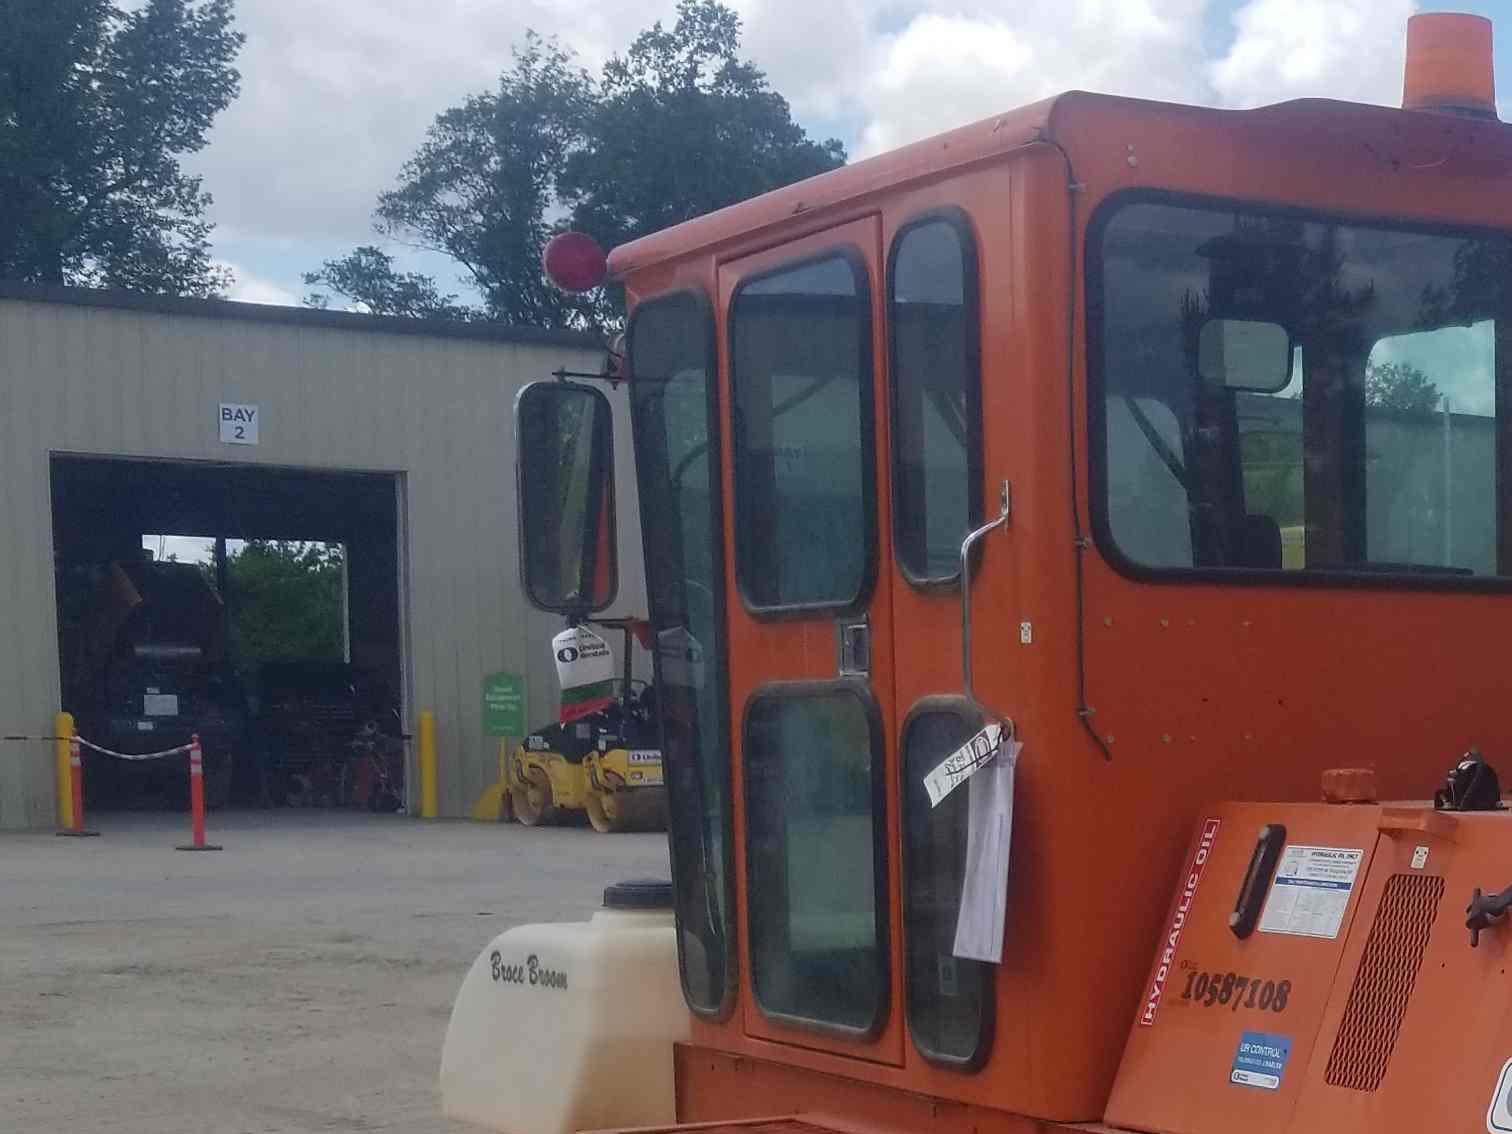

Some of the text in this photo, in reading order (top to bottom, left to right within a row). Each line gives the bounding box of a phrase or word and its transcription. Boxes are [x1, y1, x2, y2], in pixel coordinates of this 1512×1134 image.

[222, 407, 255, 422] BAY
[235, 426, 245, 439] 2
[1143, 872, 1199, 1020] HYDRAULIC
[1195, 824, 1217, 865] OIL
[490, 950, 569, 990] Broce Broom
[1182, 971, 1292, 1013] 10587108
